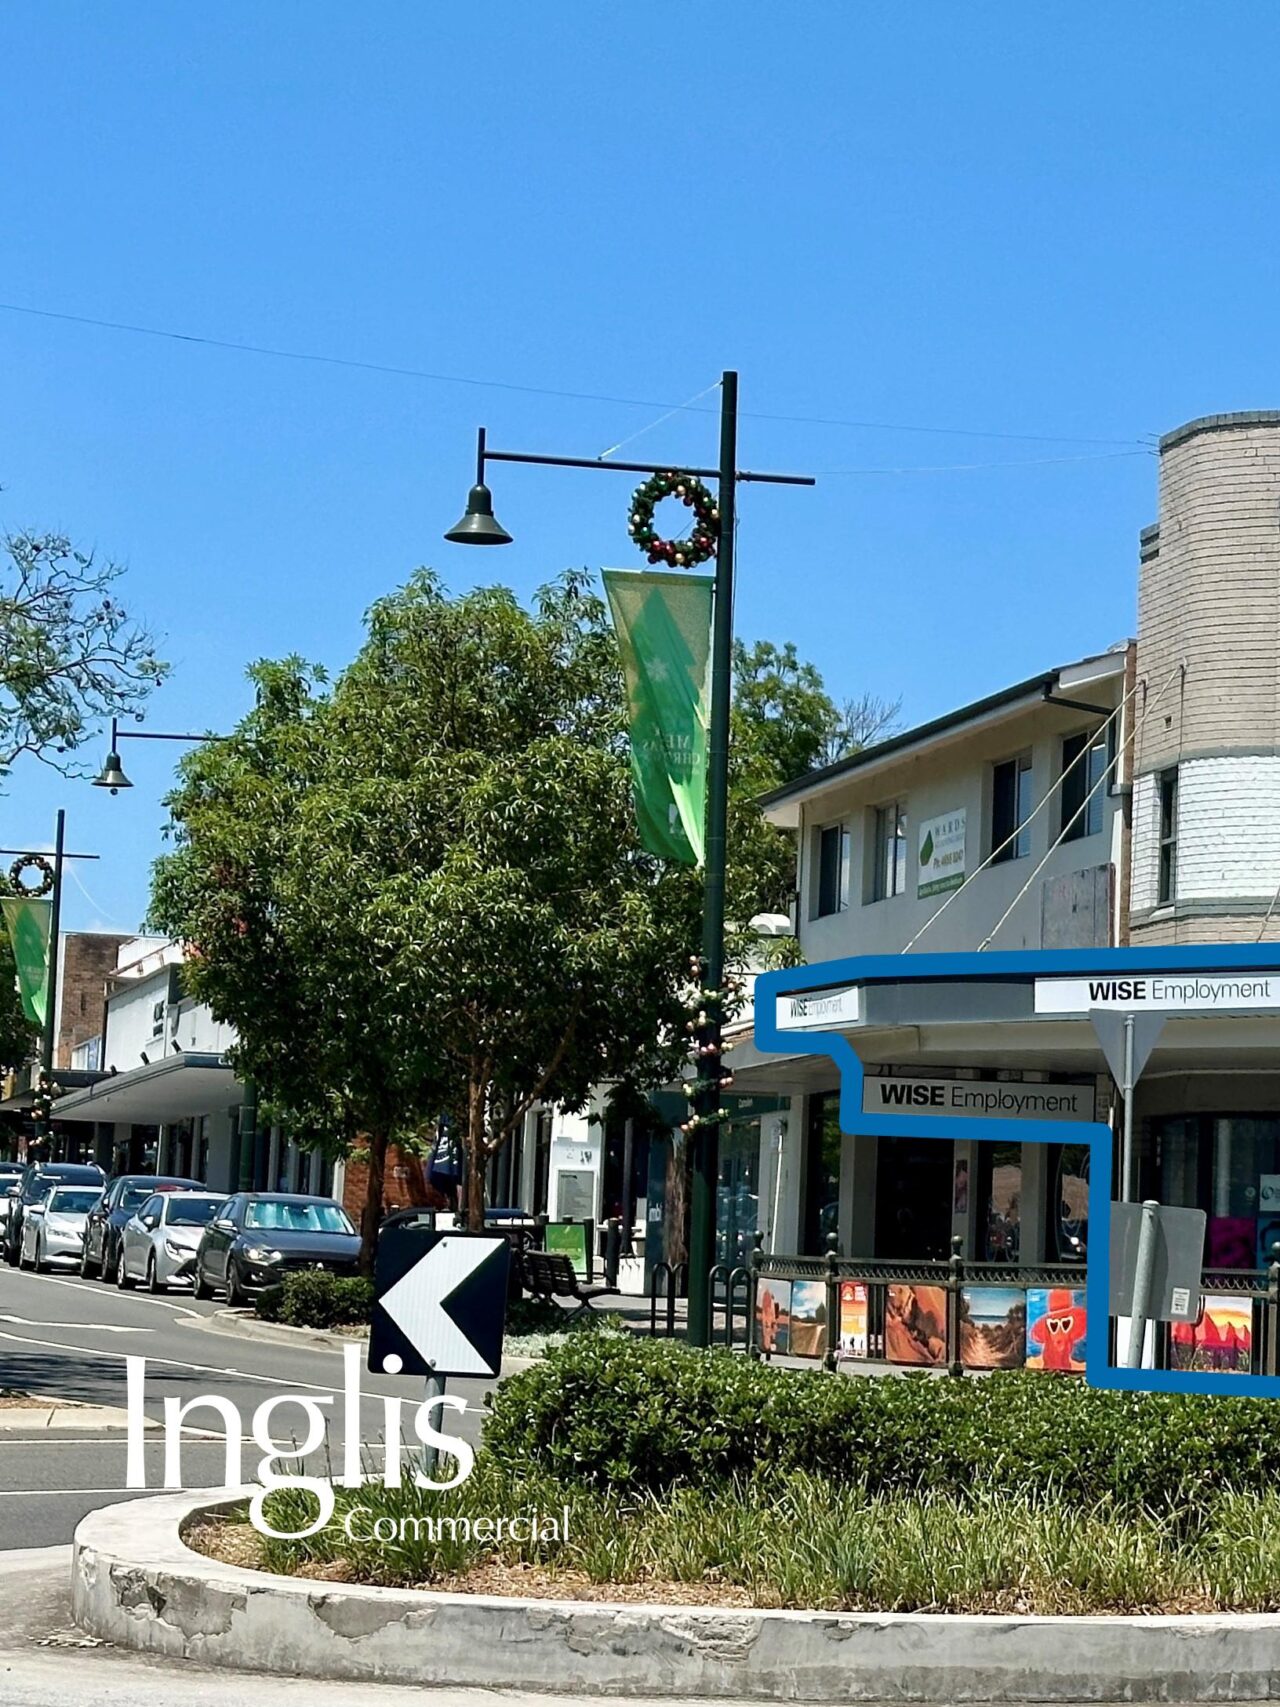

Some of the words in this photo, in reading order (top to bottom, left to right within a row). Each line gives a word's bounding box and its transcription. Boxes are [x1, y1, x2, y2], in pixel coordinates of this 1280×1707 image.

[1088, 981, 1146, 1001] WISE
[1152, 979, 1271, 1004] Employment
[880, 1083, 945, 1106] WISE
[951, 1086, 1078, 1114] Employment
